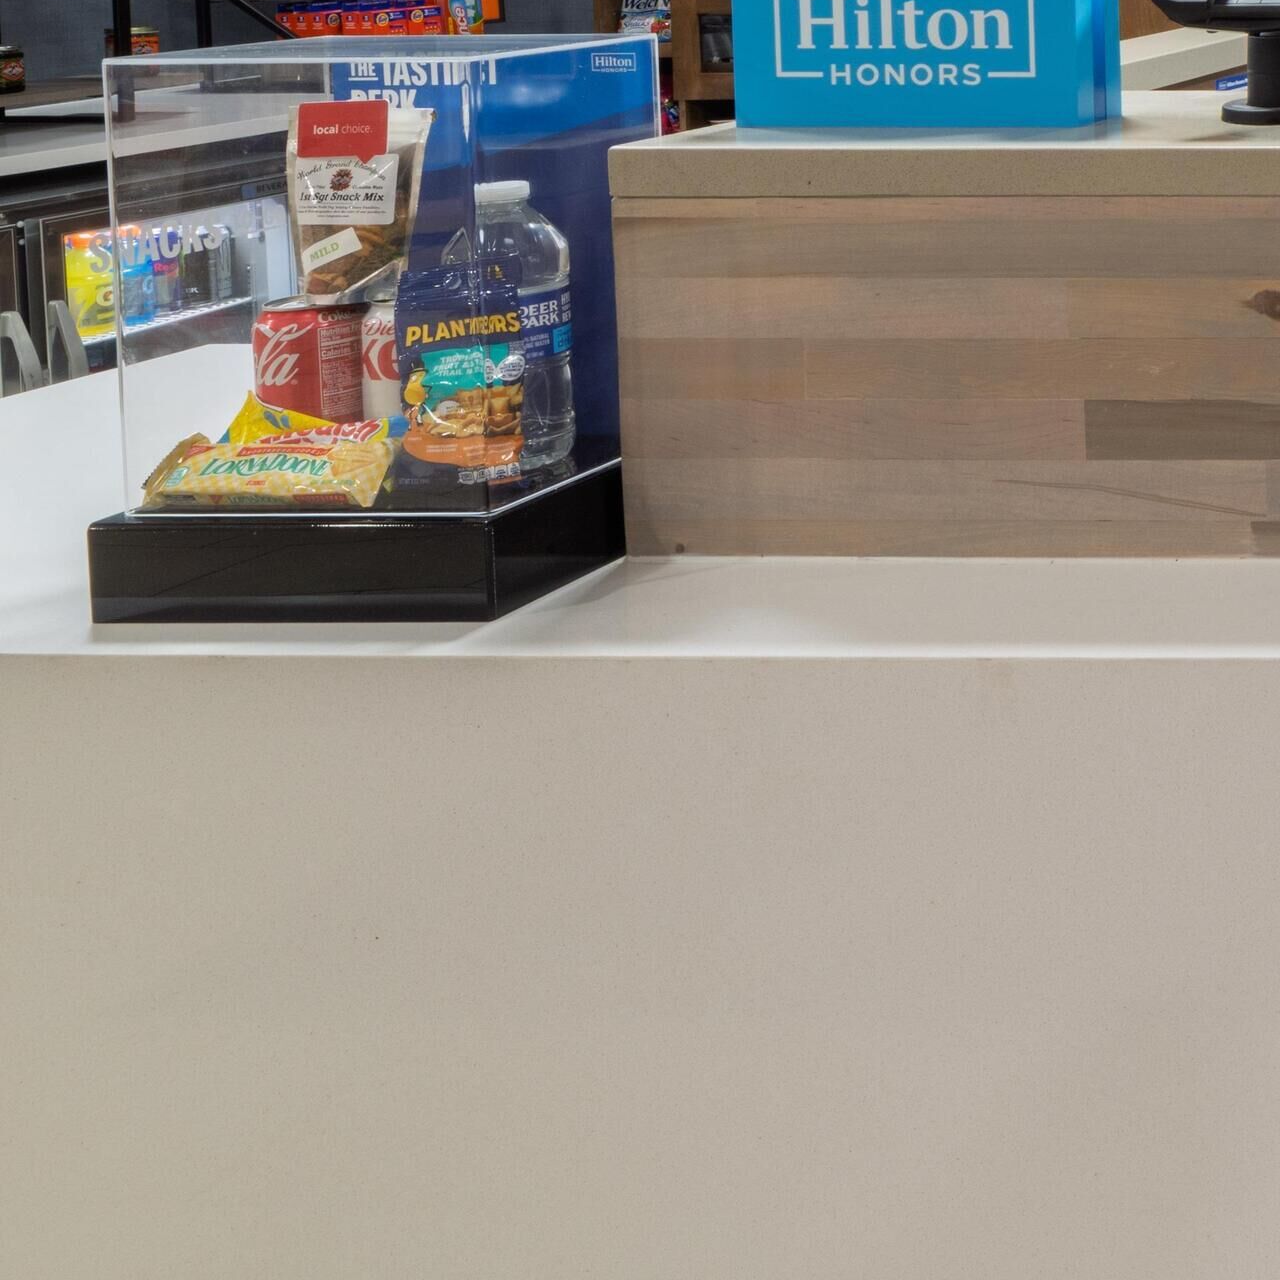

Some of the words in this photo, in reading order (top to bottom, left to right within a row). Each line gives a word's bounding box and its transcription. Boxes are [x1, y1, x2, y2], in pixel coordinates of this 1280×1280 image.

[349, 61, 377, 77] THE
[594, 56, 633, 67] Hilton
[830, 62, 982, 87] HONORS
[313, 125, 338, 135] local
[341, 124, 373, 135] choice.
[312, 192, 329, 203] Sgt
[330, 192, 361, 201] Snack
[362, 193, 385, 201] Mix
[89, 220, 224, 273] SNACKS
[309, 242, 340, 262] MILD
[519, 300, 558, 318] DEER
[364, 318, 395, 336] Die
[253, 322, 315, 387] la
